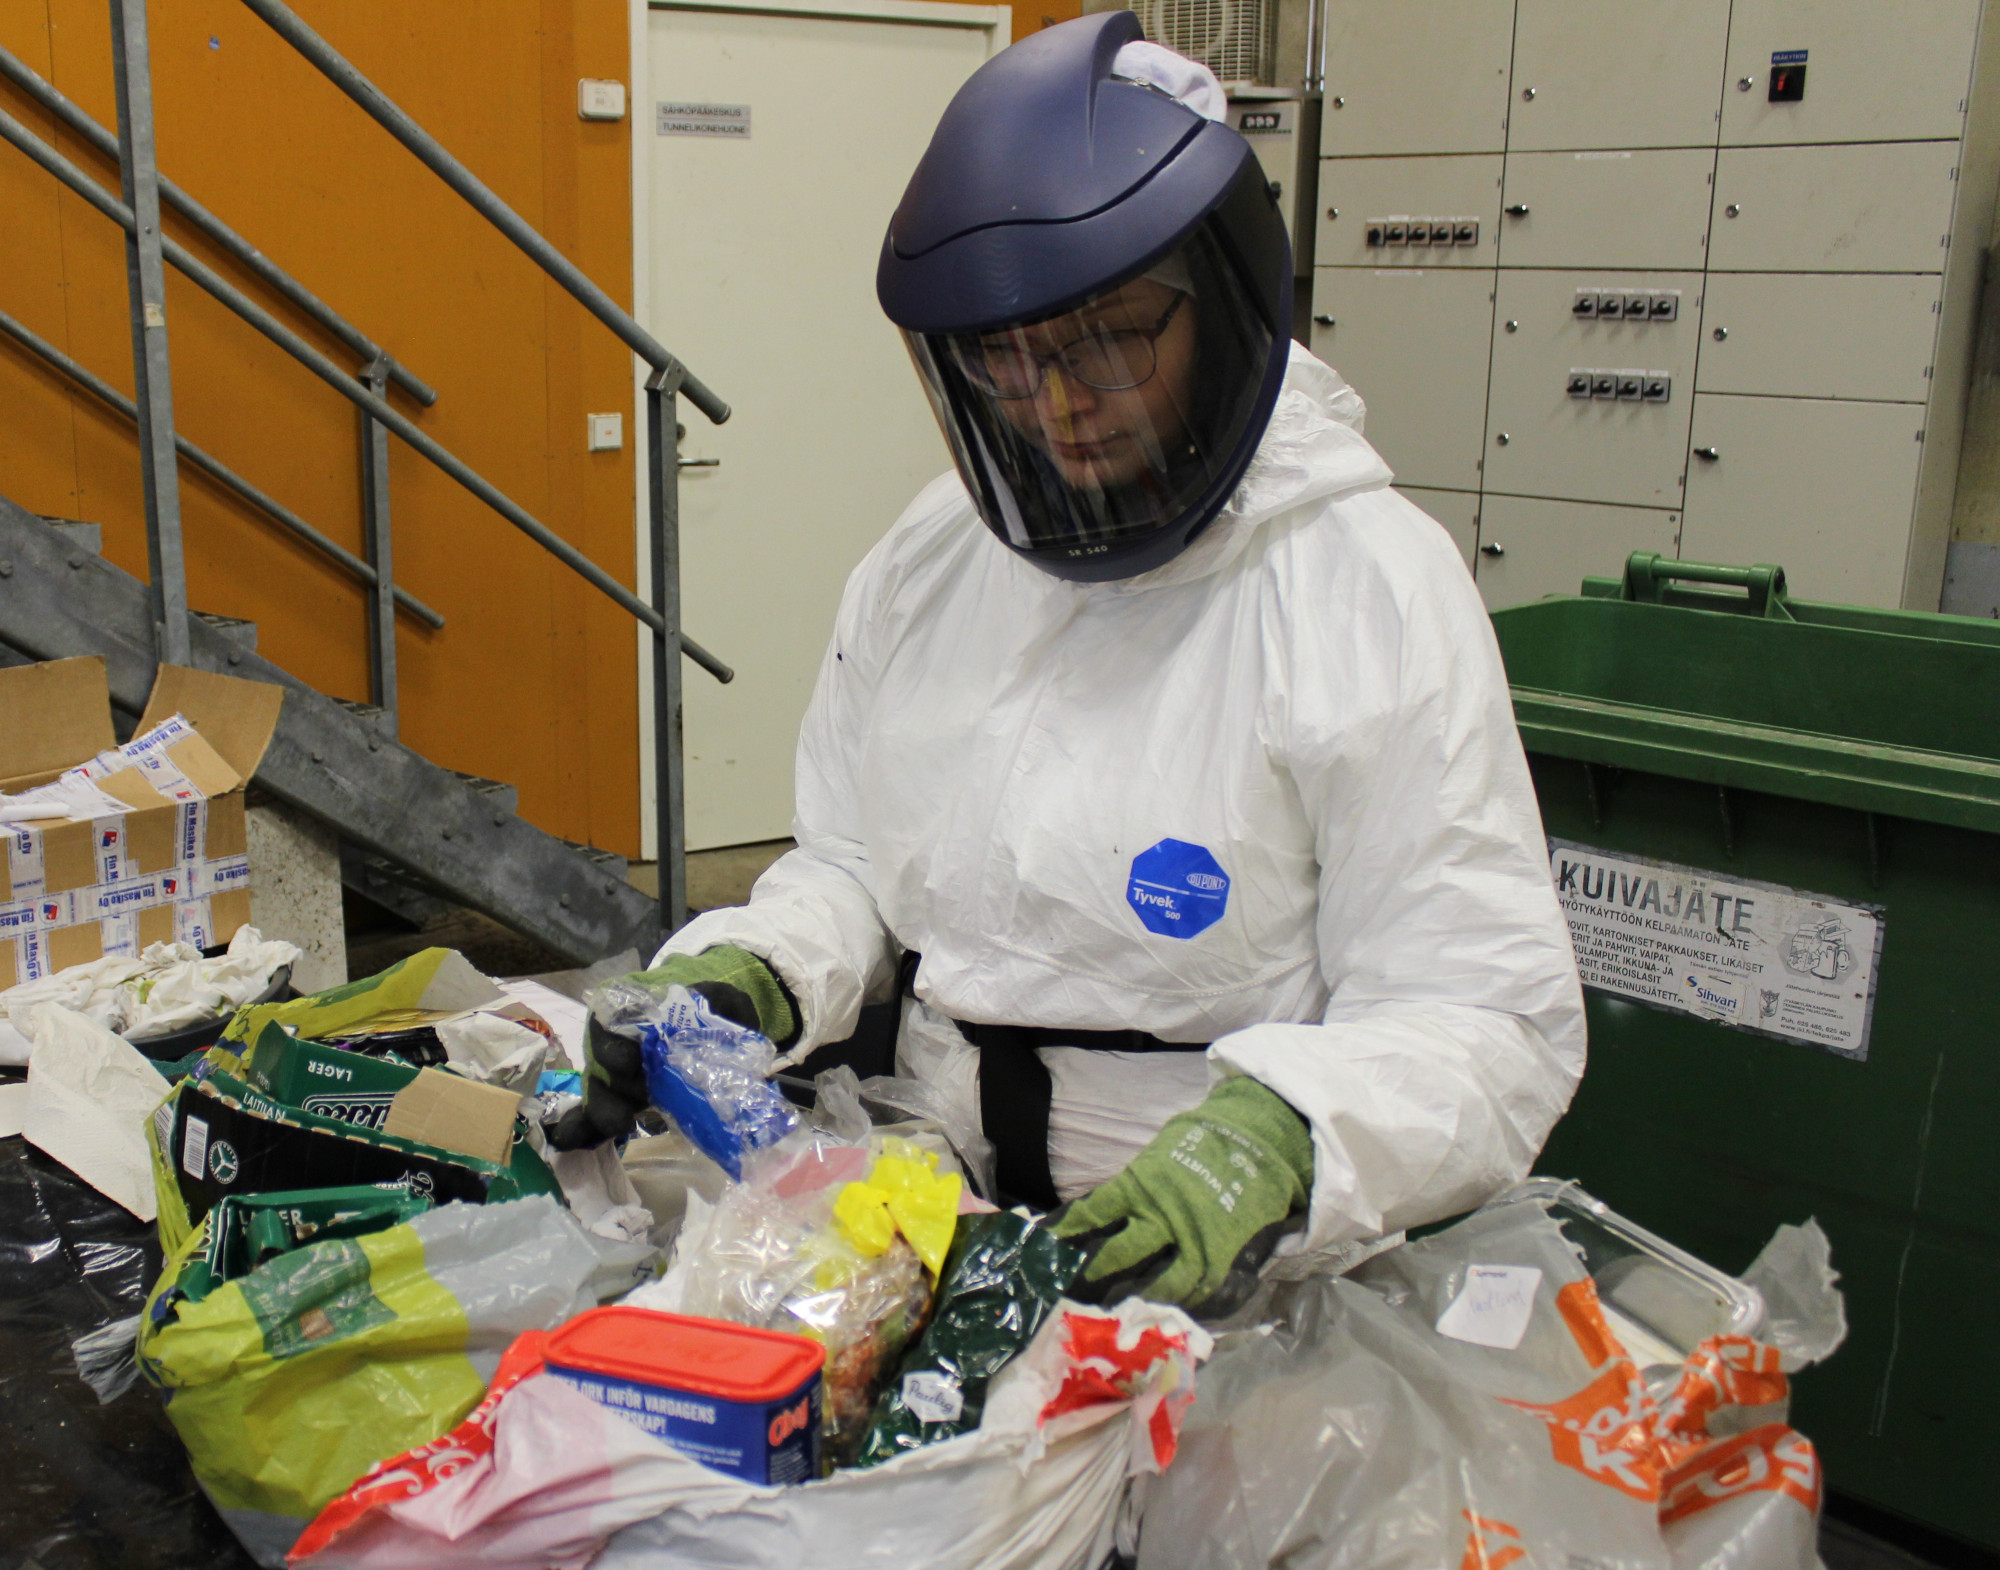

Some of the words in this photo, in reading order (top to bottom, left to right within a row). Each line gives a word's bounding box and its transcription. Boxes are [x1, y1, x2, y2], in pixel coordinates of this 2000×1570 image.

[663, 122, 745, 134] TUNNELIKONEHUONE
[1068, 549, 1082, 557] SR
[1086, 545, 1108, 555] 540
[168, 723, 183, 734] Fin
[137, 730, 169, 752] Masiko
[187, 802, 198, 815] Fin
[186, 817, 198, 851] Masiko
[108, 855, 118, 870] Fin
[213, 871, 224, 882] Oy
[225, 868, 250, 880] asiko
[110, 889, 141, 905] Masiko
[142, 887, 156, 898] Fin
[1133, 887, 1175, 909] Tyvek
[1560, 860, 1755, 934] KUIVAJÄTE
[98, 896, 110, 908] Oy
[21, 912, 35, 923] Fin
[1165, 910, 1181, 921] 500
[1559, 898, 1643, 926] HYÖTYKÄYTTÖÖN
[1645, 919, 1720, 945] KELPAAMATON
[1567, 920, 1591, 935] OVIT,
[1592, 925, 1655, 948] KARTONKISET
[1656, 941, 1719, 965] PAKKAUKSET,
[1720, 956, 1764, 974] LIKAISET
[1571, 931, 1591, 944] ERIT
[1592, 938, 1603, 948] JA
[1605, 940, 1637, 957] PAHVIT,
[1640, 948, 1671, 965] VAIPAT,
[1573, 943, 1620, 965] KULAMPUT,
[1622, 956, 1660, 973] IKKUNA-
[1662, 966, 1674, 977] JA
[1575, 955, 1599, 970] LASIT,
[1601, 962, 1662, 985] ERIKOISLASIT
[1590, 973, 1599, 982] EI
[1696, 987, 1737, 1009] Sihvari
[307, 1060, 353, 1082] LAGER
[242, 1092, 287, 1119] LAITILAN
[238, 1209, 303, 1227] LER
[606, 1388, 642, 1410] INFÖR
[643, 1394, 717, 1425] VARDAGENS
